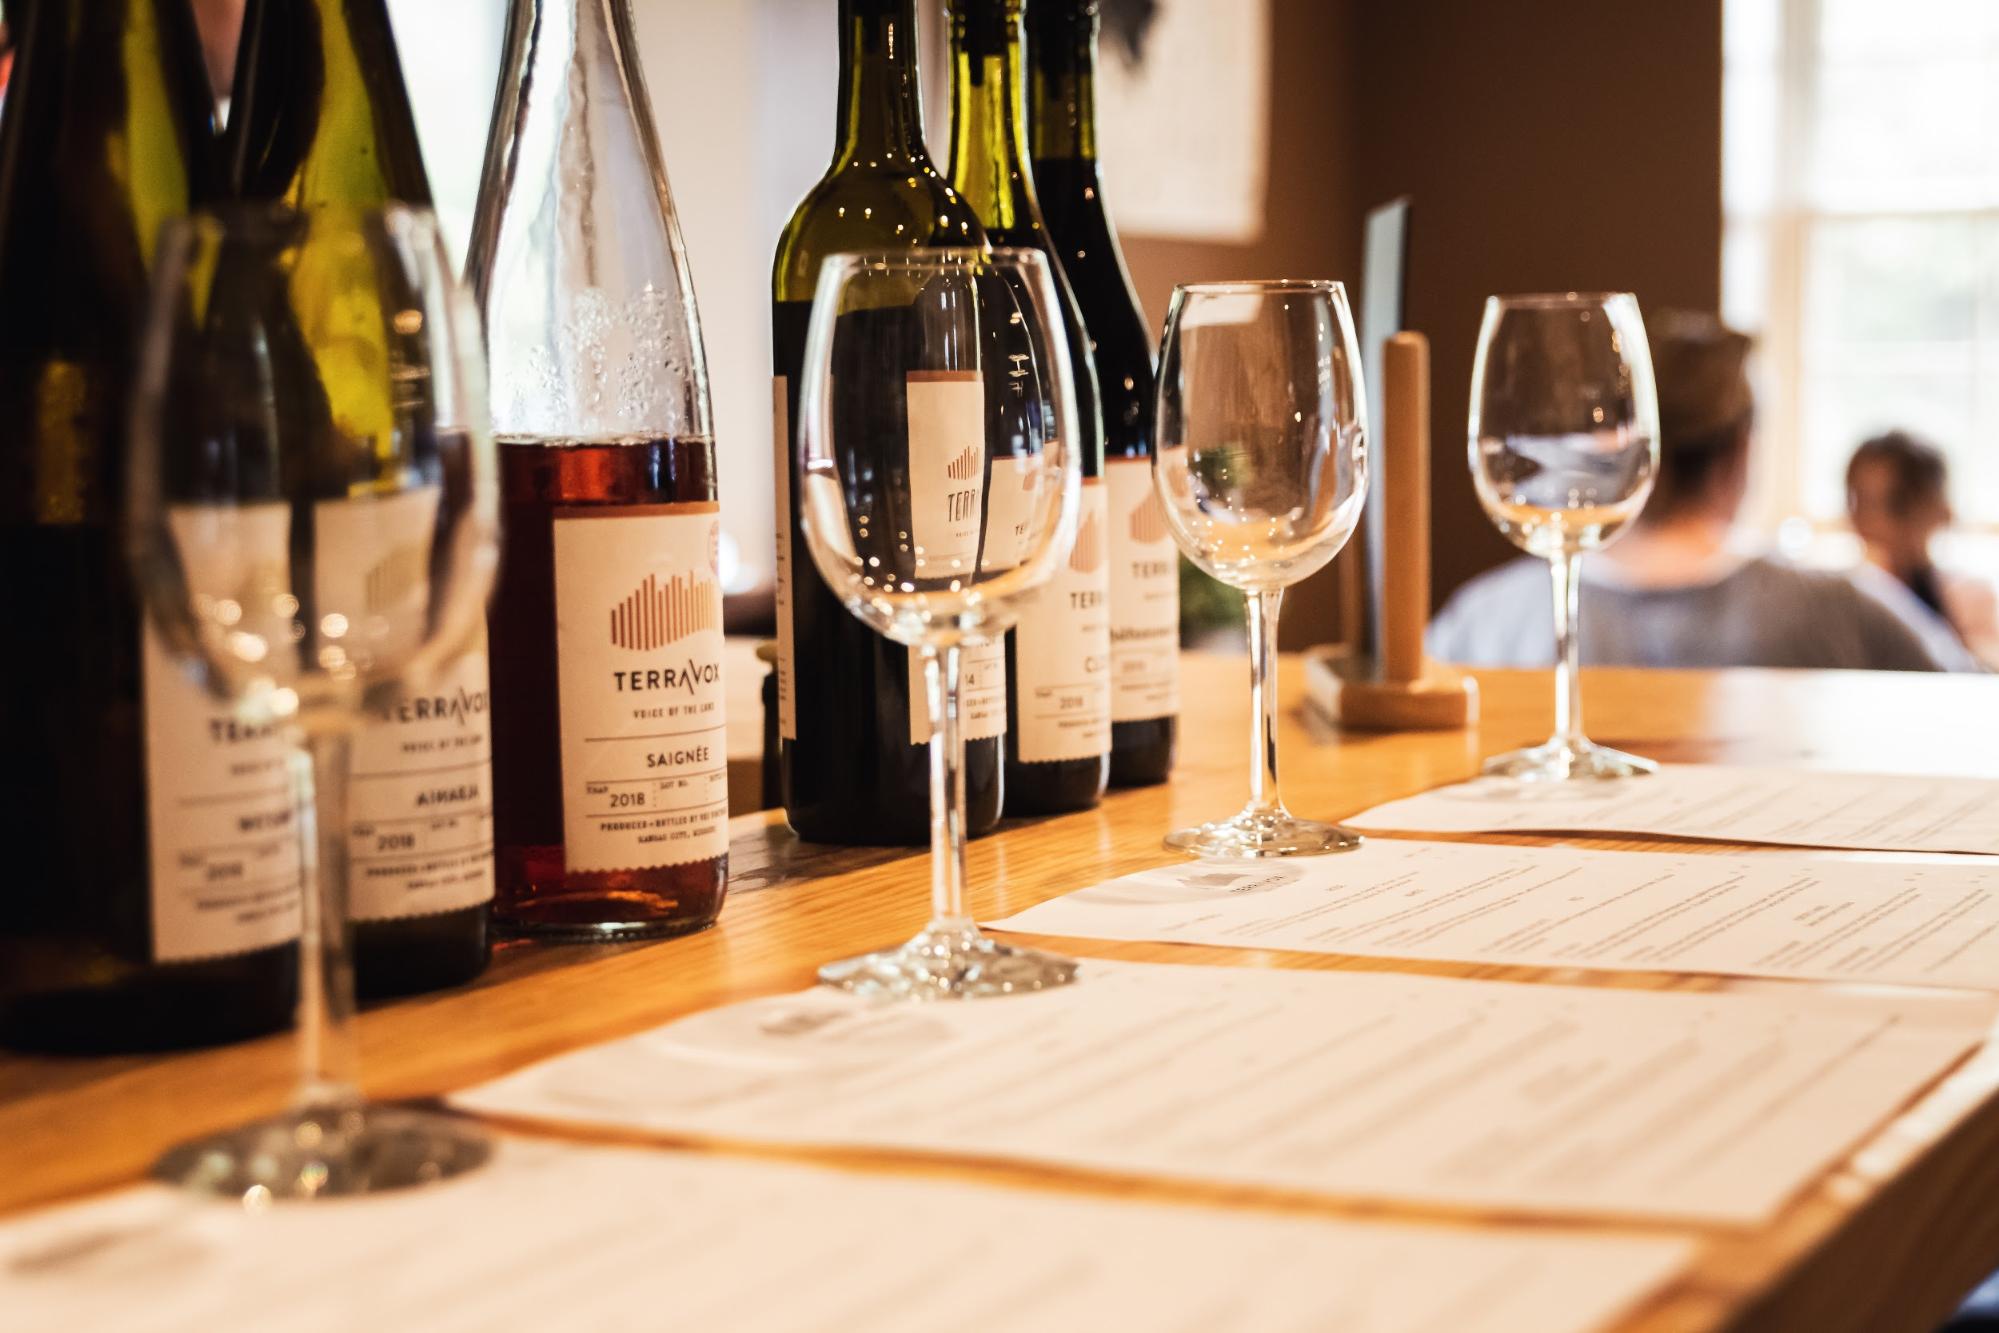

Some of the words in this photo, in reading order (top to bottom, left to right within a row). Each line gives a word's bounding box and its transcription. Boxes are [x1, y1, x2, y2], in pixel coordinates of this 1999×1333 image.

[614, 659, 720, 696] TERRAVOX
[646, 746, 710, 768] SAIGNÉE
[610, 792, 646, 808] 2018
